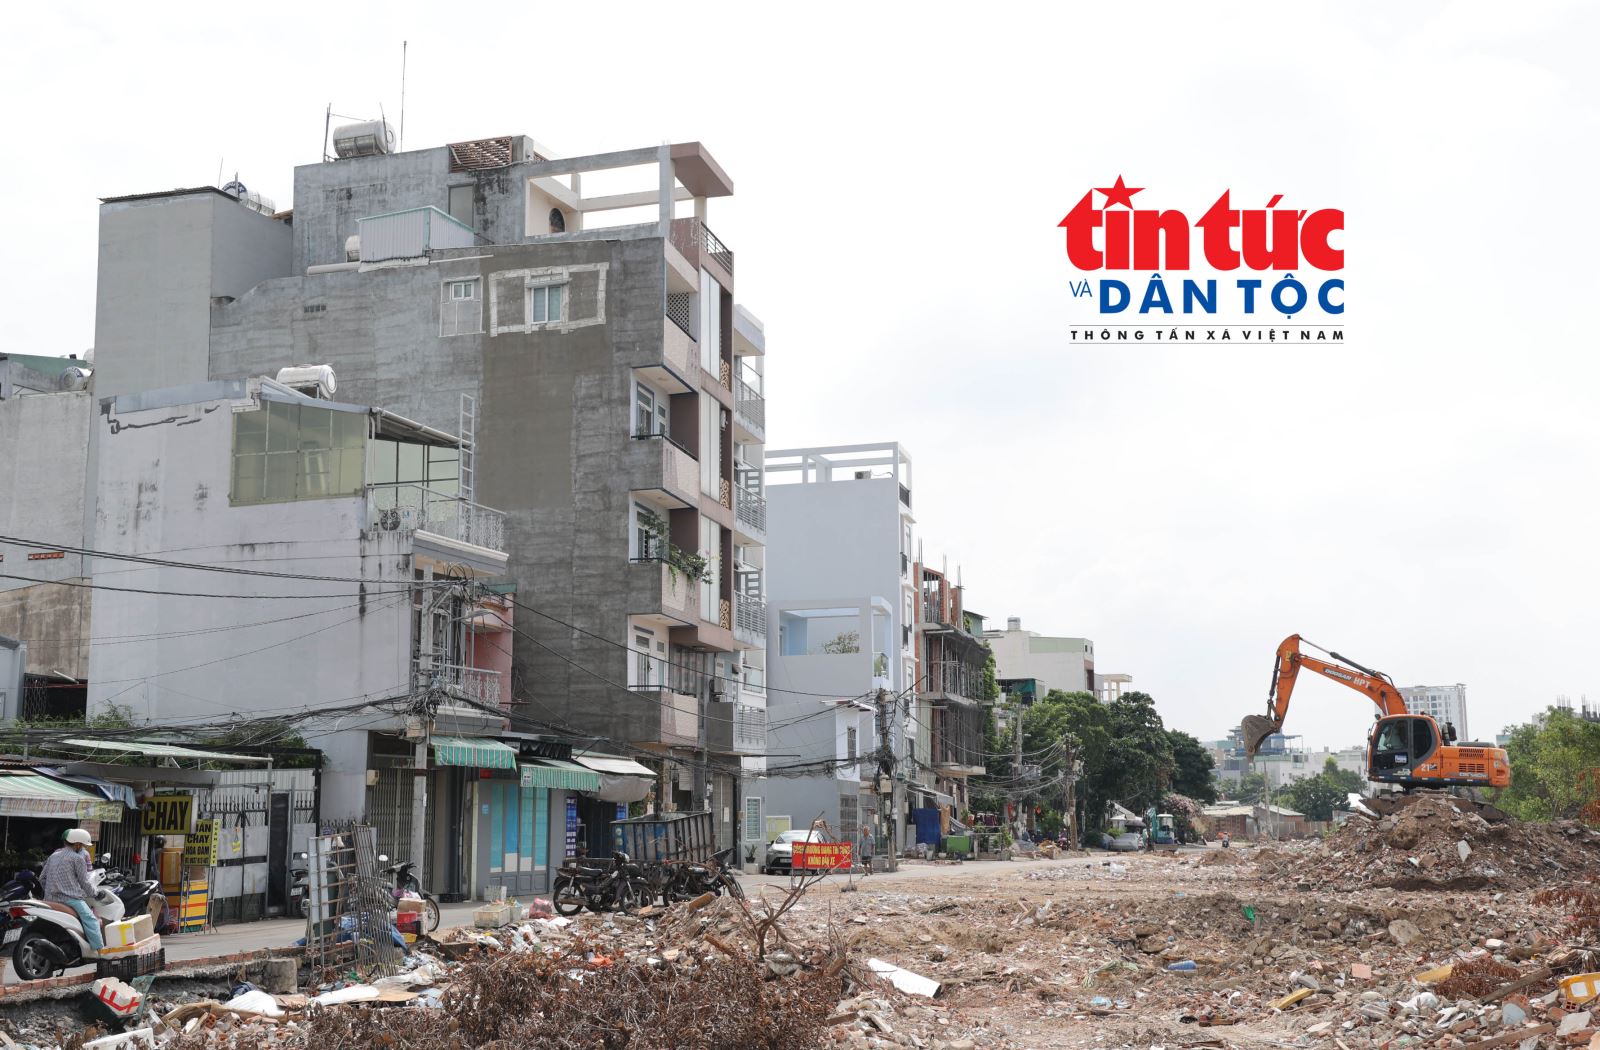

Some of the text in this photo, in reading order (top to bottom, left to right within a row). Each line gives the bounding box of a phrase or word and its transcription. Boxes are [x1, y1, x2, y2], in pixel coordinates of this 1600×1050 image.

[1353, 677, 1370, 689] HPT
[144, 801, 189, 830] CHAY
[187, 834, 209, 843] CHAY
